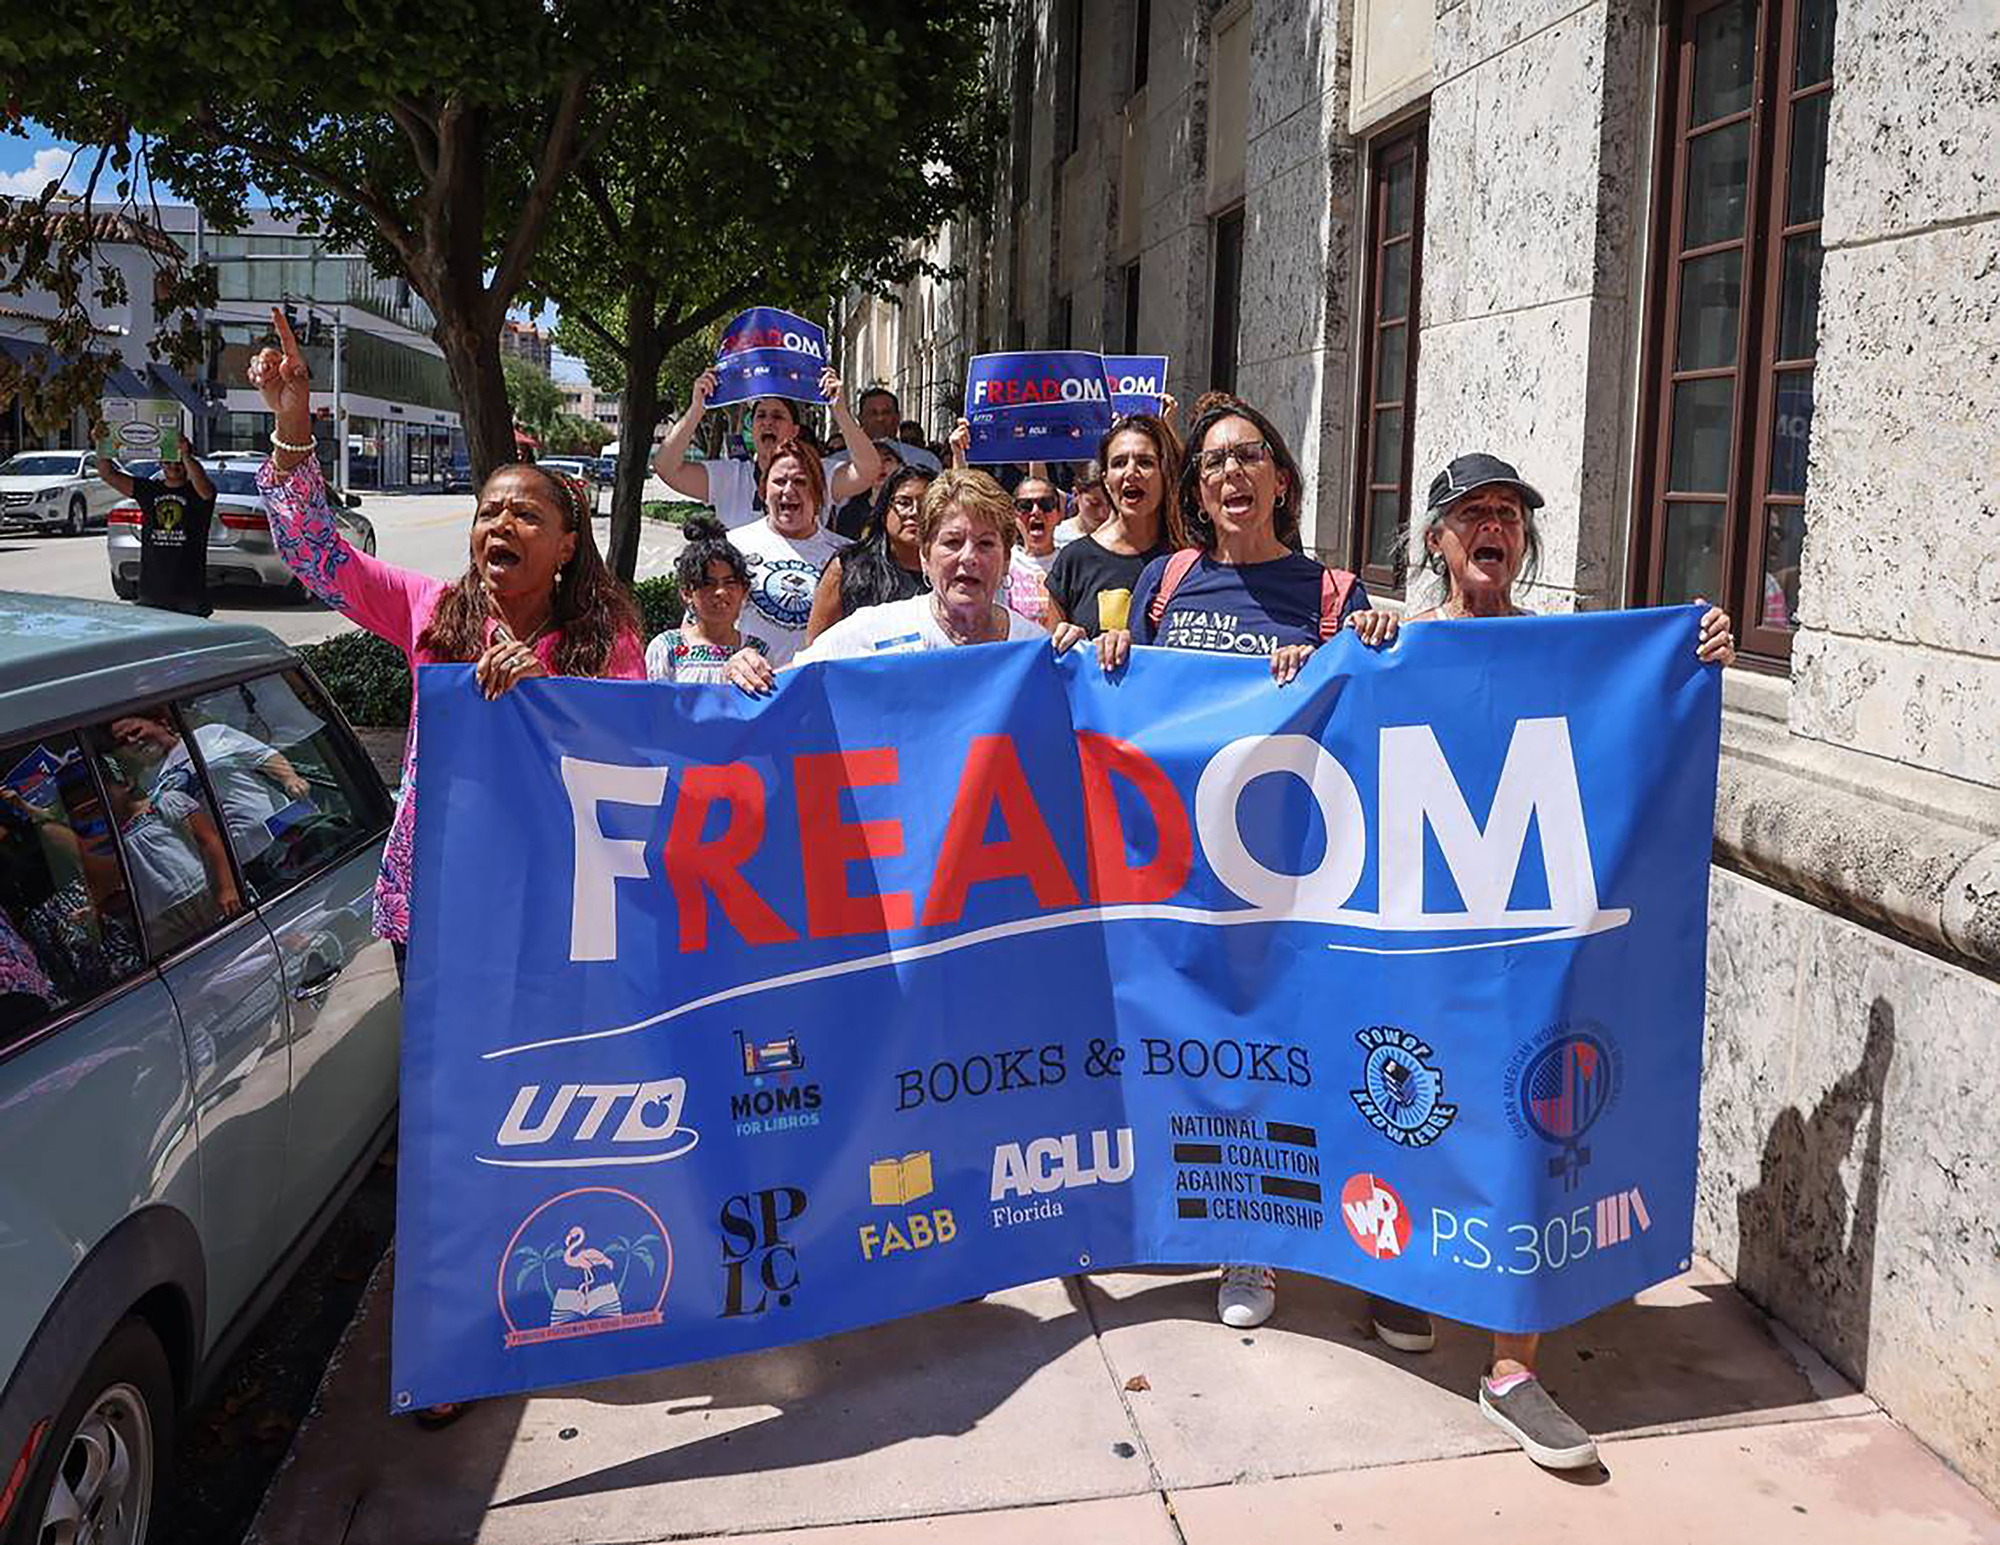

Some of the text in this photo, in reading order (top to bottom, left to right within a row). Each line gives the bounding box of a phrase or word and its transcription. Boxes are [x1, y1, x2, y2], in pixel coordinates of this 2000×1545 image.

[975, 378, 1106, 404] FREADOM
[1170, 611, 1237, 631] MIAMI
[1166, 628, 1278, 653] FREEDOM
[561, 716, 1600, 962] FREADOM
[895, 1037, 1312, 1112] BOOKS & BOOKS
[731, 1084, 822, 1120] MOMS
[736, 1112, 820, 1137] FOR LIBROS
[1171, 1115, 1264, 1141] NATIONAL
[990, 1127, 1135, 1202] ACLU
[1227, 1144, 1320, 1177] COALITION
[1176, 1169, 1261, 1194] AGAINST
[992, 1199, 1064, 1229] Florida
[1212, 1197, 1324, 1231] CENSORSHIP
[858, 1208, 958, 1262] FABB
